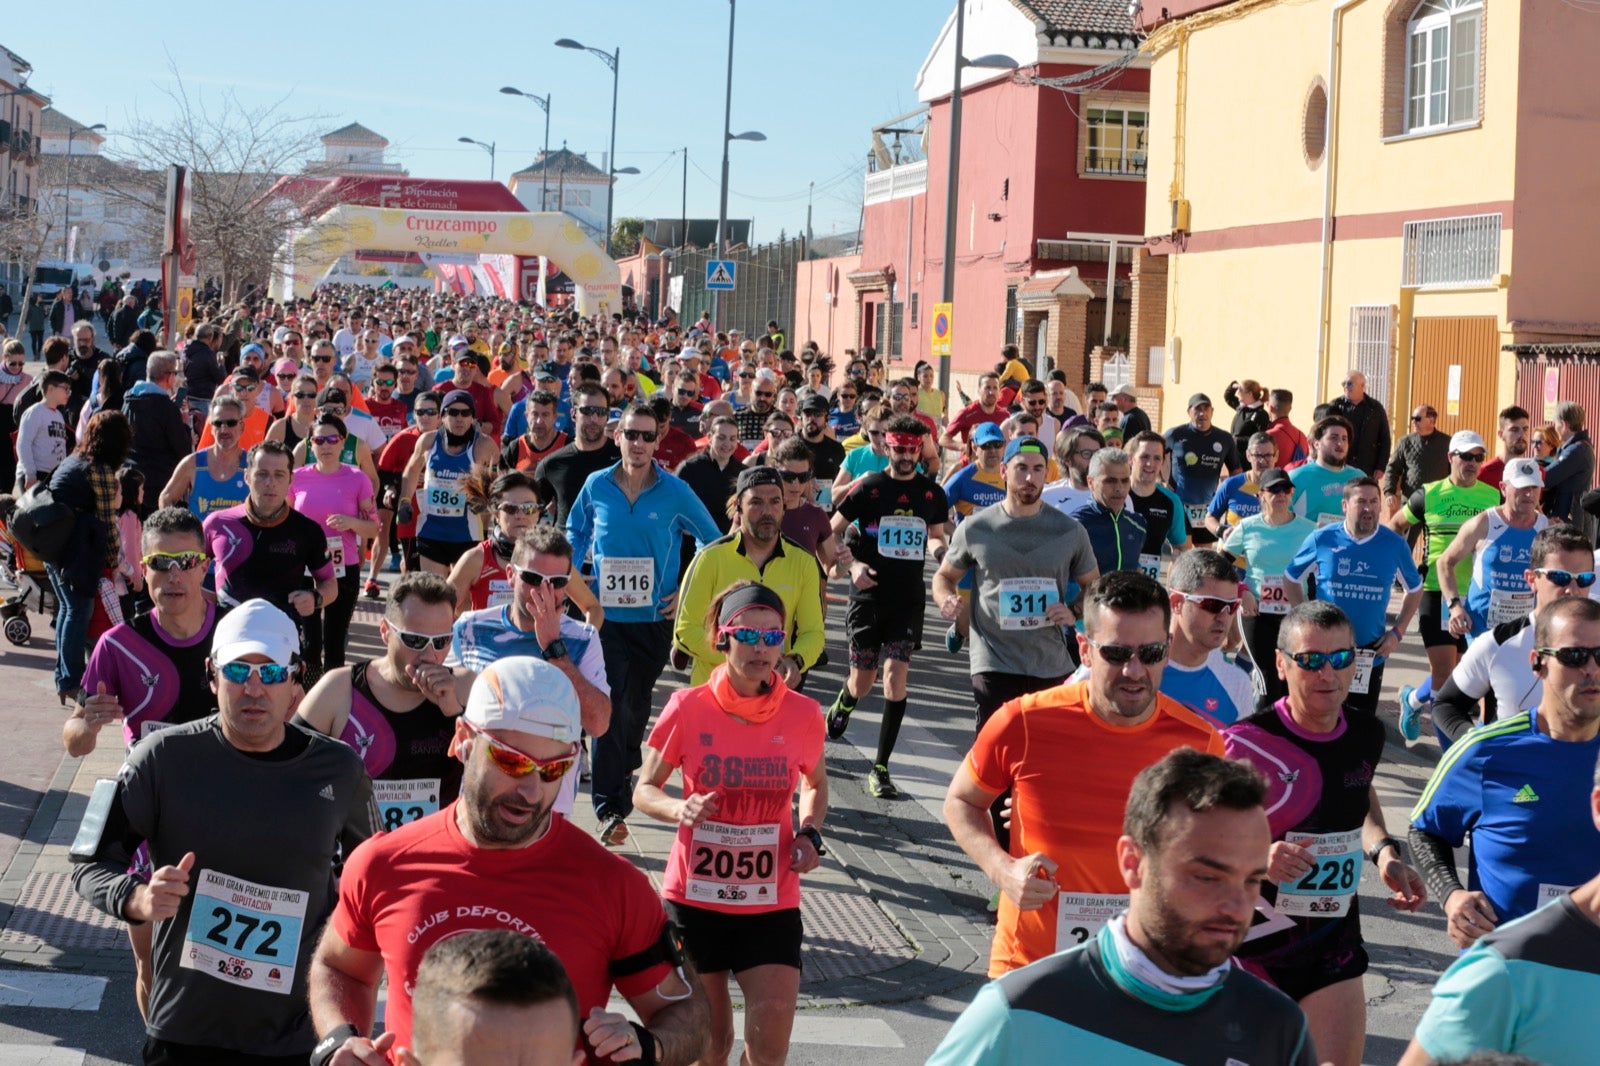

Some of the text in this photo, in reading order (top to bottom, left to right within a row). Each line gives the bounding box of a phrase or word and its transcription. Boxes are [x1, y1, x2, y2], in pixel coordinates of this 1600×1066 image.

[404, 186, 458, 198] Diputación
[404, 198, 458, 210] de Granada
[406, 215, 497, 234] Cruzcampo
[414, 236, 458, 248] Radler
[432, 490, 459, 505] 586
[1235, 503, 1260, 516] agust
[882, 529, 923, 546] 1135
[606, 575, 650, 590] 3116
[1344, 583, 1383, 592] ATLETISMO
[1262, 587, 1289, 602] 20
[1010, 594, 1047, 613] 311
[744, 763, 787, 777] MEDIA
[386, 783, 408, 791] PREMIO
[409, 783, 416, 791] DE
[417, 781, 435, 790] FONDO
[377, 792, 412, 801] DIPUTACIÓN
[715, 825, 730, 835] GRAN
[730, 828, 750, 836] PREMIO
[750, 828, 757, 836] DE
[757, 827, 775, 835] FONDO
[693, 846, 774, 880] 2050
[1297, 858, 1355, 890] 228
[206, 873, 301, 903] XXXIII GRAN PREMIO DE FONDO
[231, 892, 273, 911] DIPUTACIÓN
[1066, 897, 1085, 905] XXXIII
[1086, 898, 1104, 906] GRAN
[206, 906, 282, 957] 272
[407, 905, 546, 945] CLUB DEPORTI
